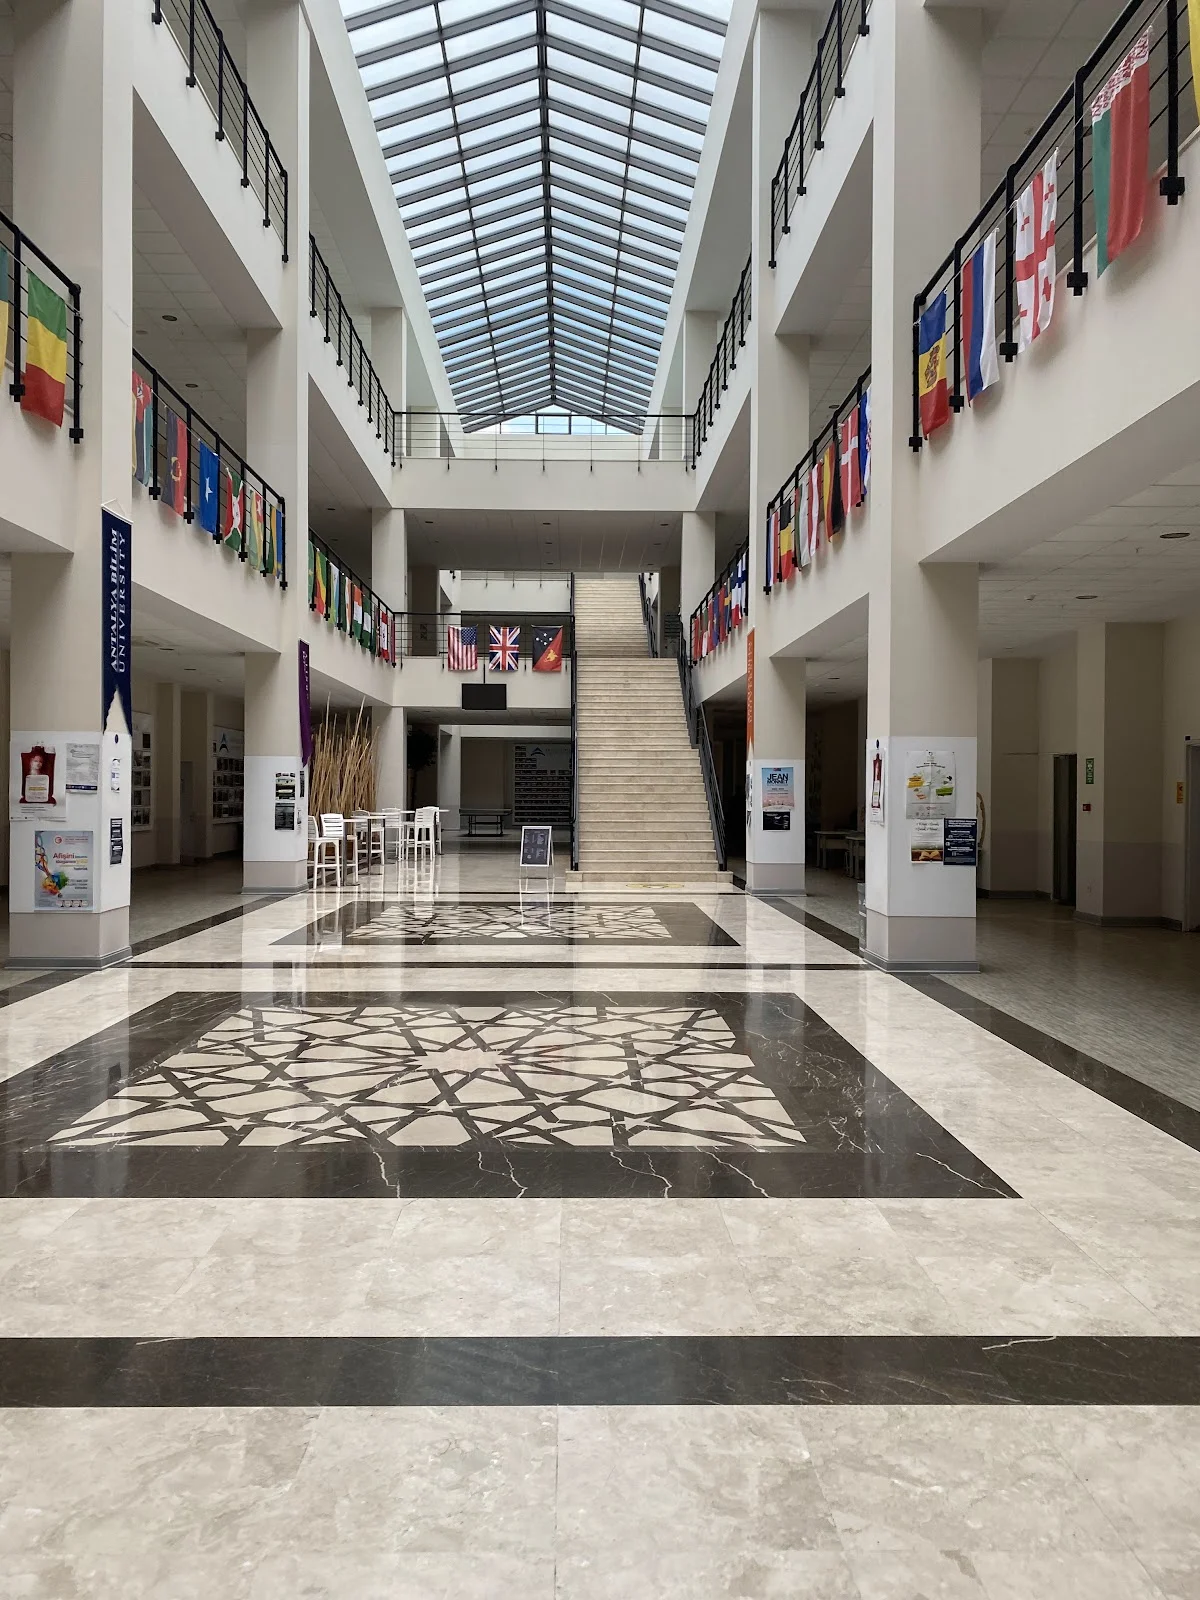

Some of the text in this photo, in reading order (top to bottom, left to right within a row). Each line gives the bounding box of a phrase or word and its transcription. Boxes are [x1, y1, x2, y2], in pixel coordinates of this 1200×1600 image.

[110, 588, 118, 672] ANTALYA
[118, 532, 126, 673] UNIVERSITY
[767, 773, 788, 781] JEAN
